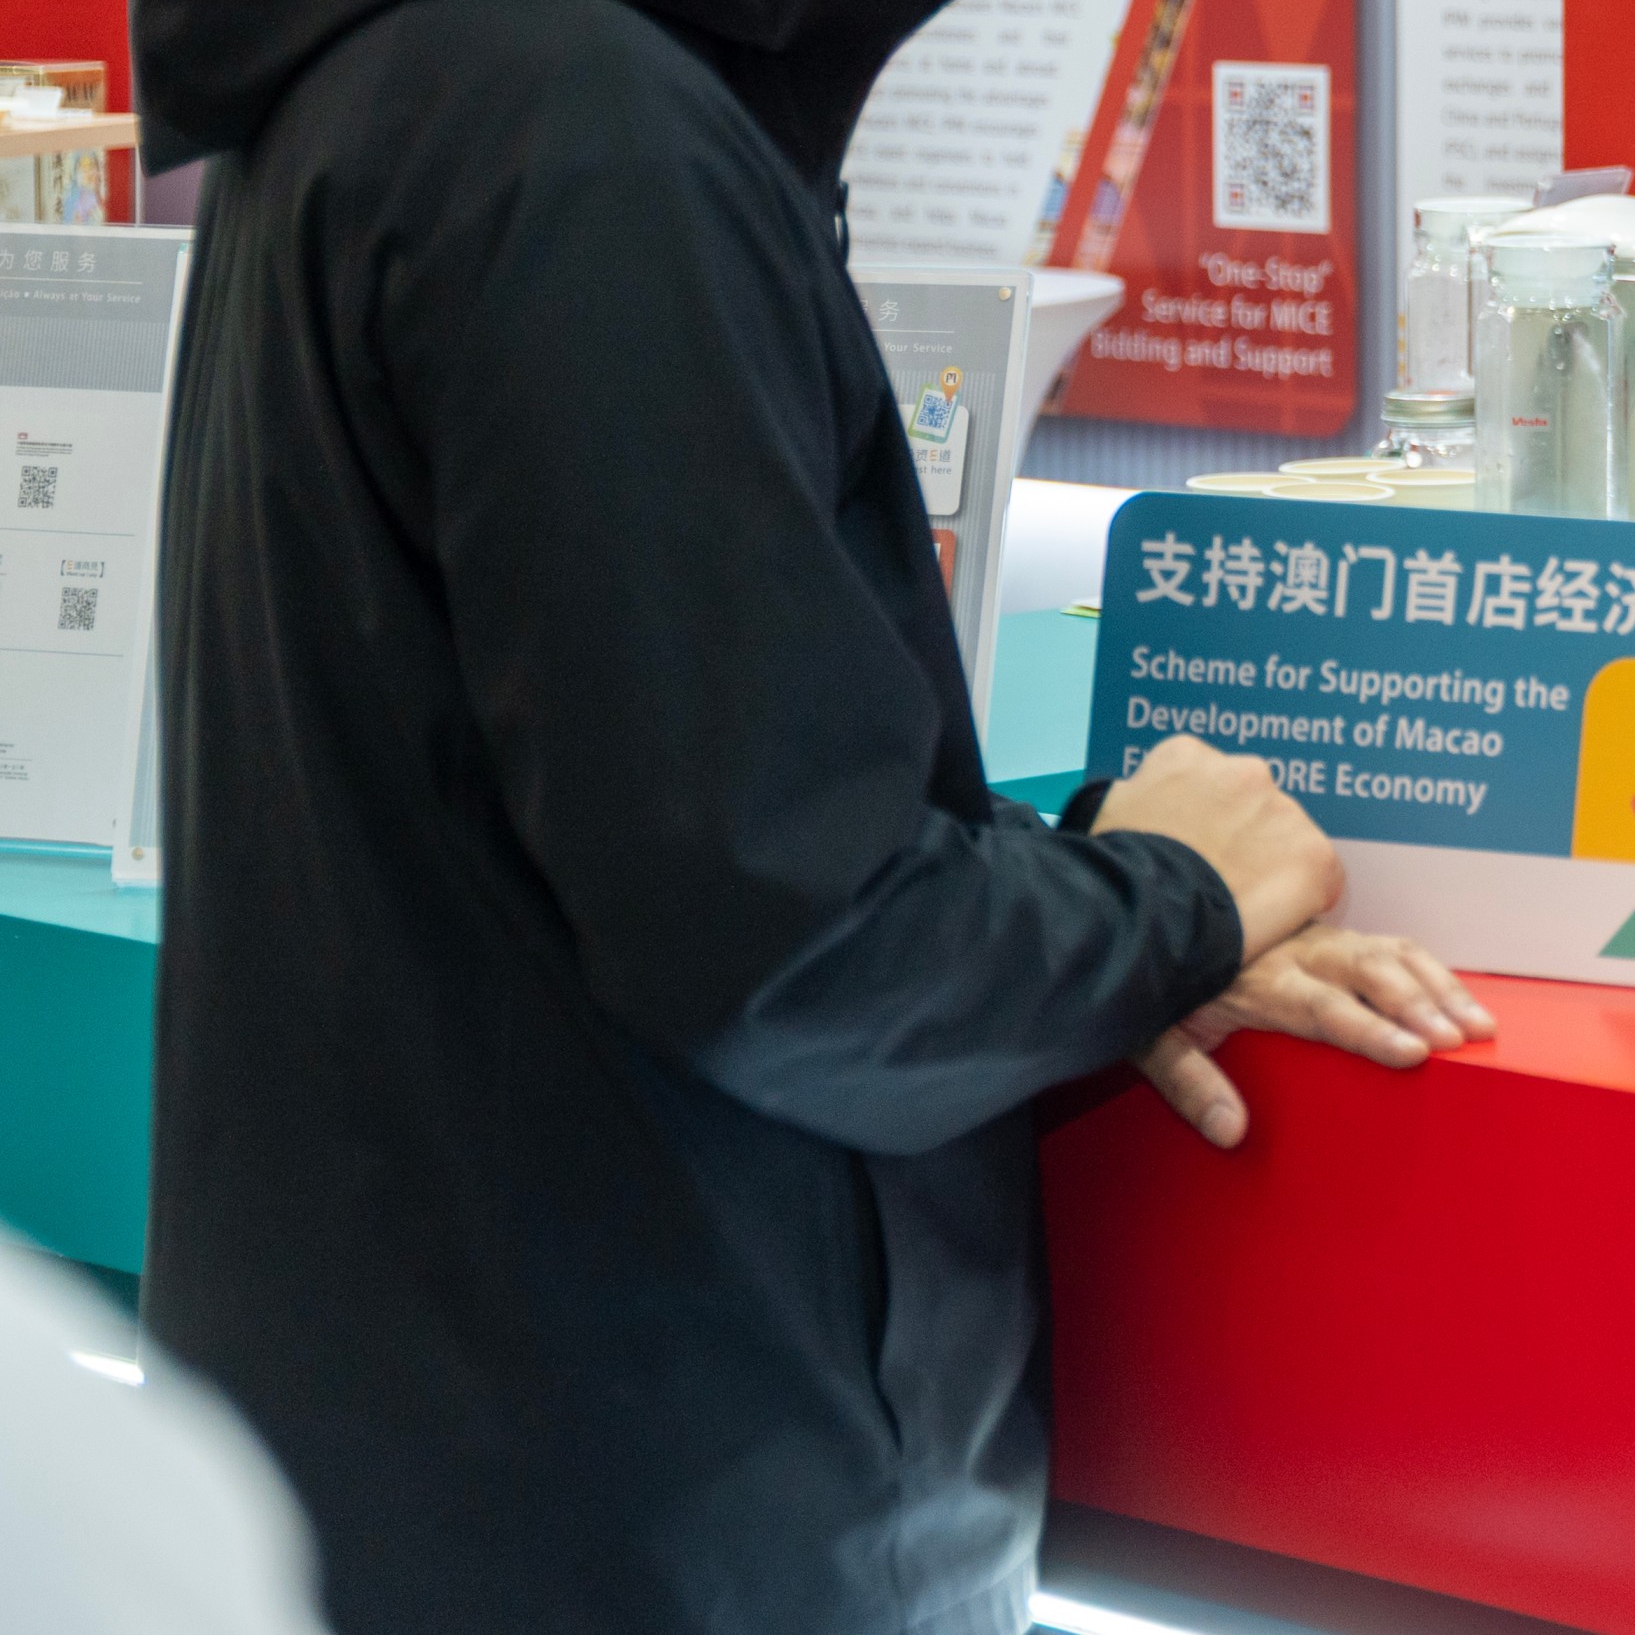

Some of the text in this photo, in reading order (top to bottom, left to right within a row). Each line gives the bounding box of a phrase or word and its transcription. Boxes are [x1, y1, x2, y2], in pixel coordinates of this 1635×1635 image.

[33, 289, 141, 303] Always at Your Service
[1142, 289, 1331, 335] Service for MICE
[1090, 326, 1332, 378] Bidding and Support
[1131, 646, 1570, 714] Scheme for Supporting the
[1128, 697, 1504, 757] Development of Macao
[1336, 764, 1488, 815] Economy
